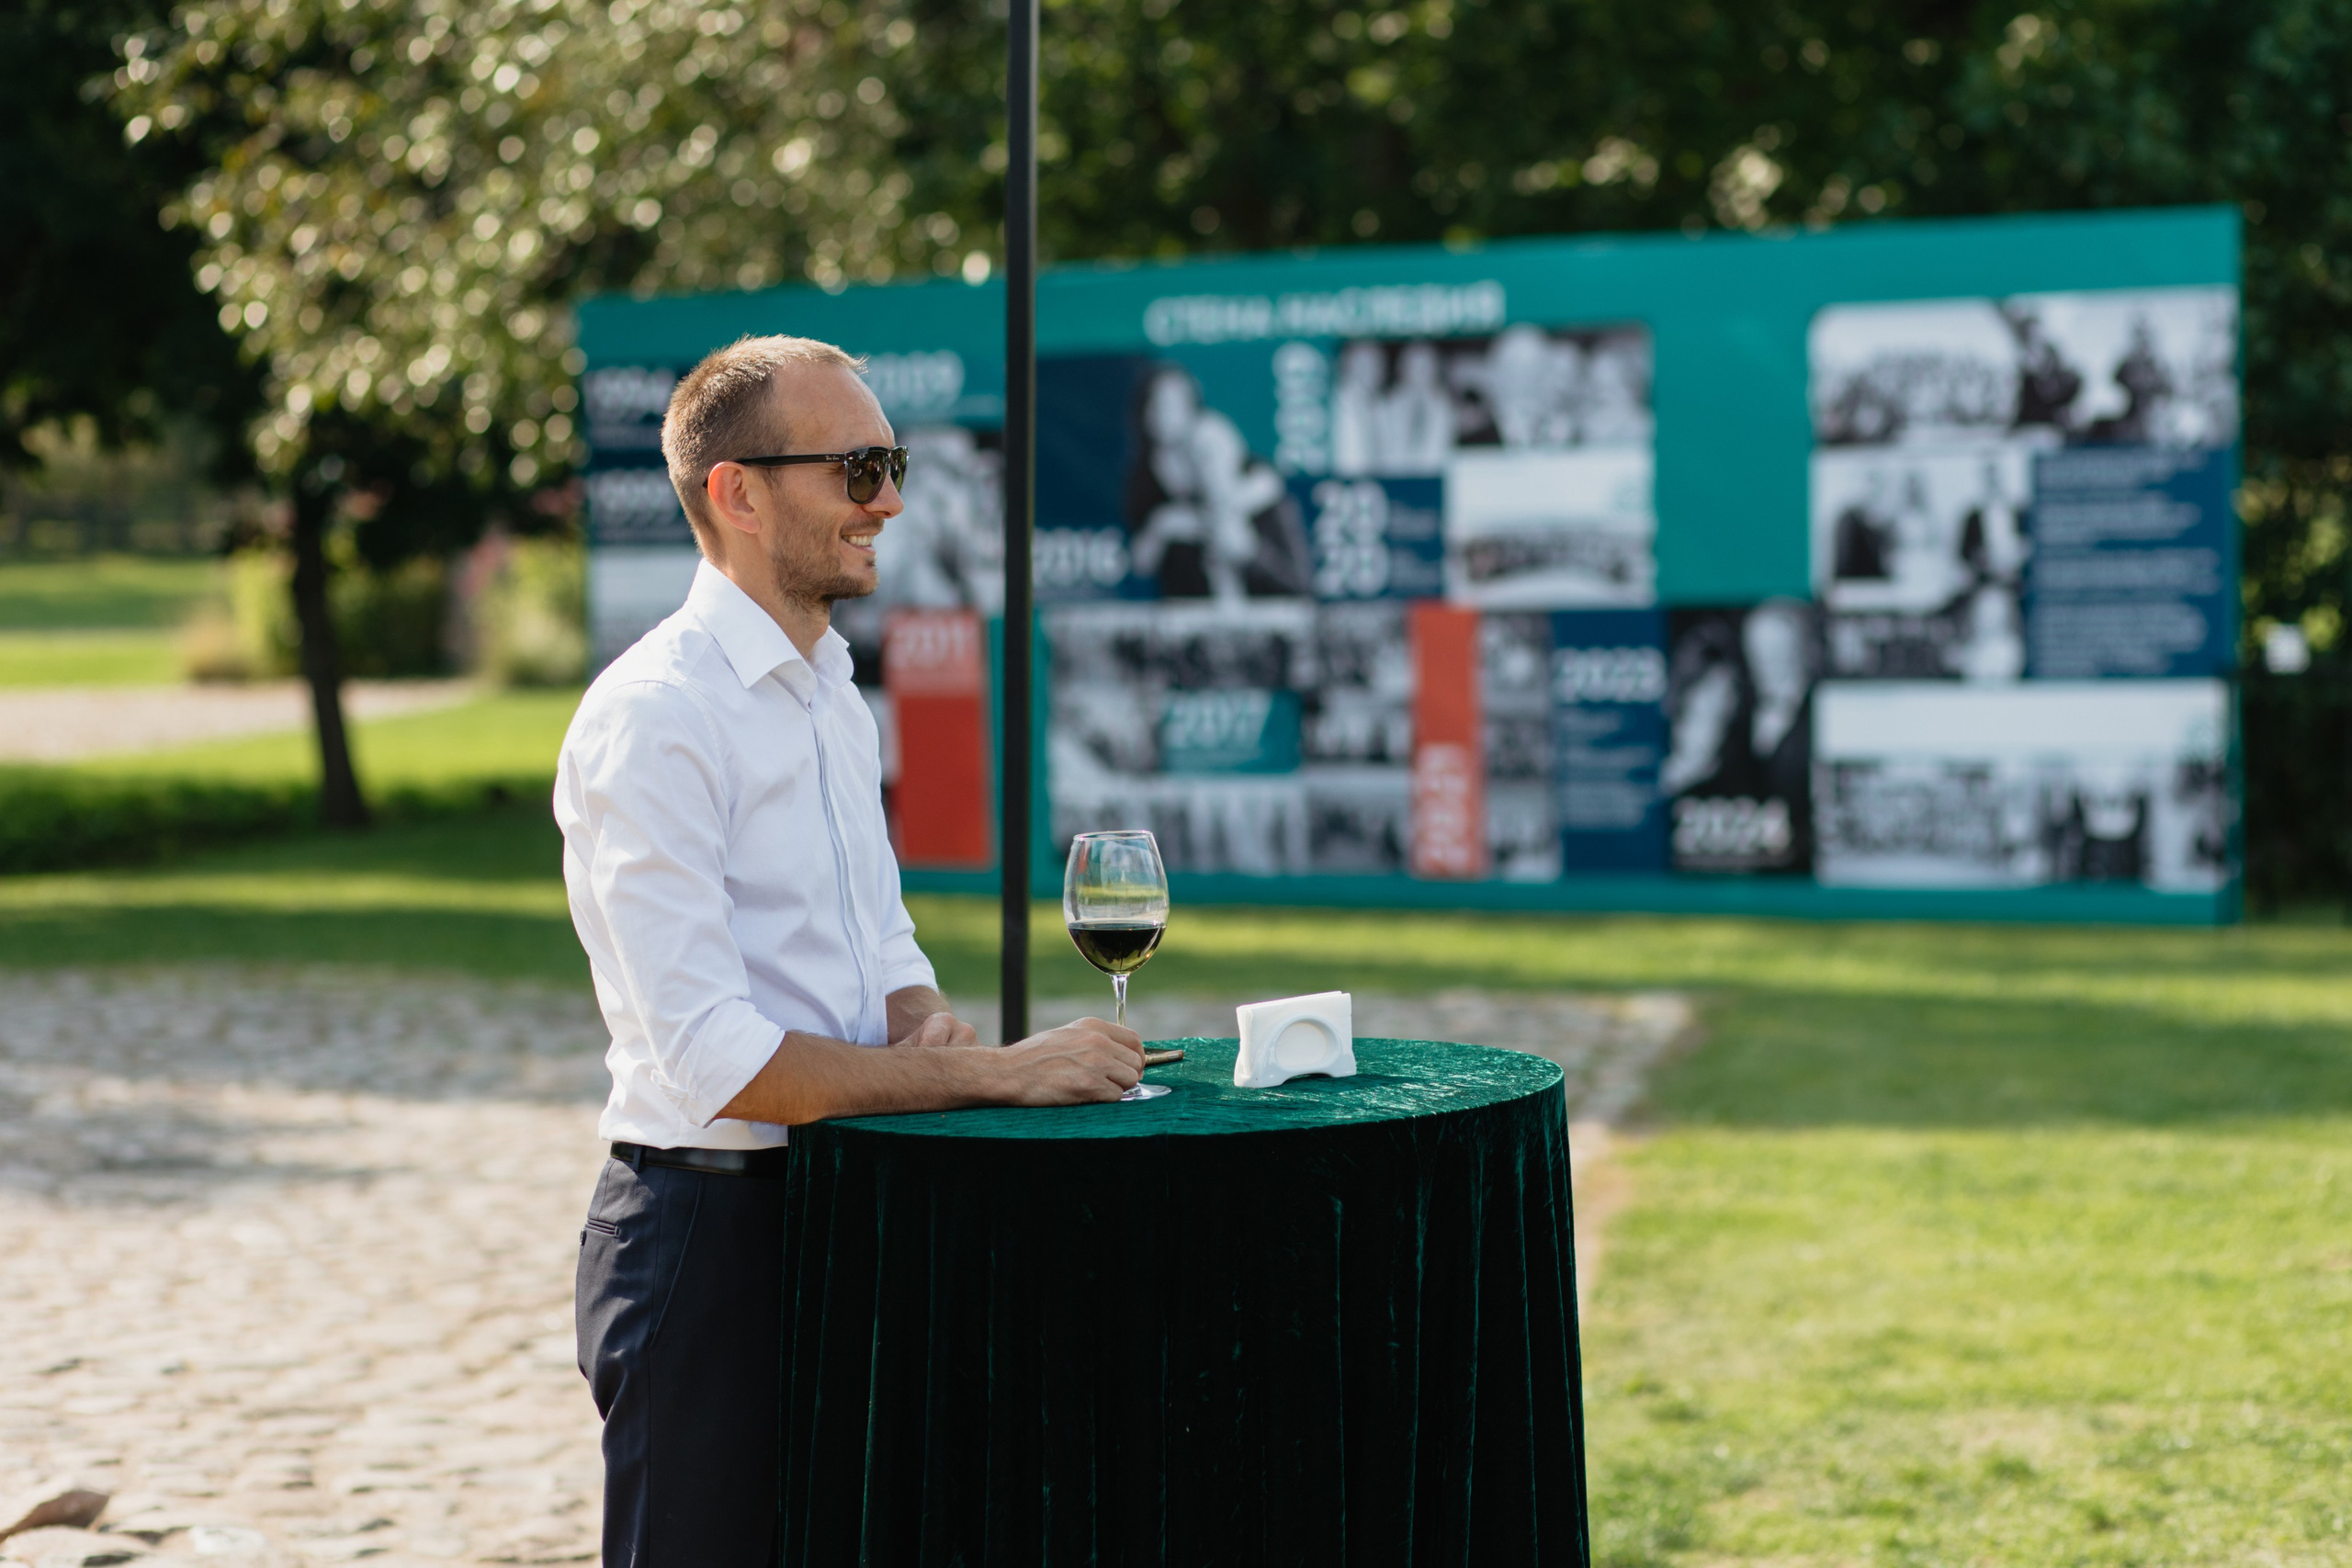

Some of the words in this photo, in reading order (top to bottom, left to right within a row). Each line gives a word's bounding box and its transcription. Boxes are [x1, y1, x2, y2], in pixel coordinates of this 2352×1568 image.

[1145, 296, 1274, 344] СТЕНА
[1278, 281, 1505, 336] НАСЛЕДИЯ
[862, 353, 965, 404] 009
[1274, 344, 1326, 471] 2019
[1316, 483, 1385, 538] 20
[1316, 539, 1385, 594] 20
[890, 615, 976, 665] 2011
[1555, 649, 1667, 701] 2023
[1160, 692, 1269, 746] 2017
[1671, 798, 1787, 852] 2024
